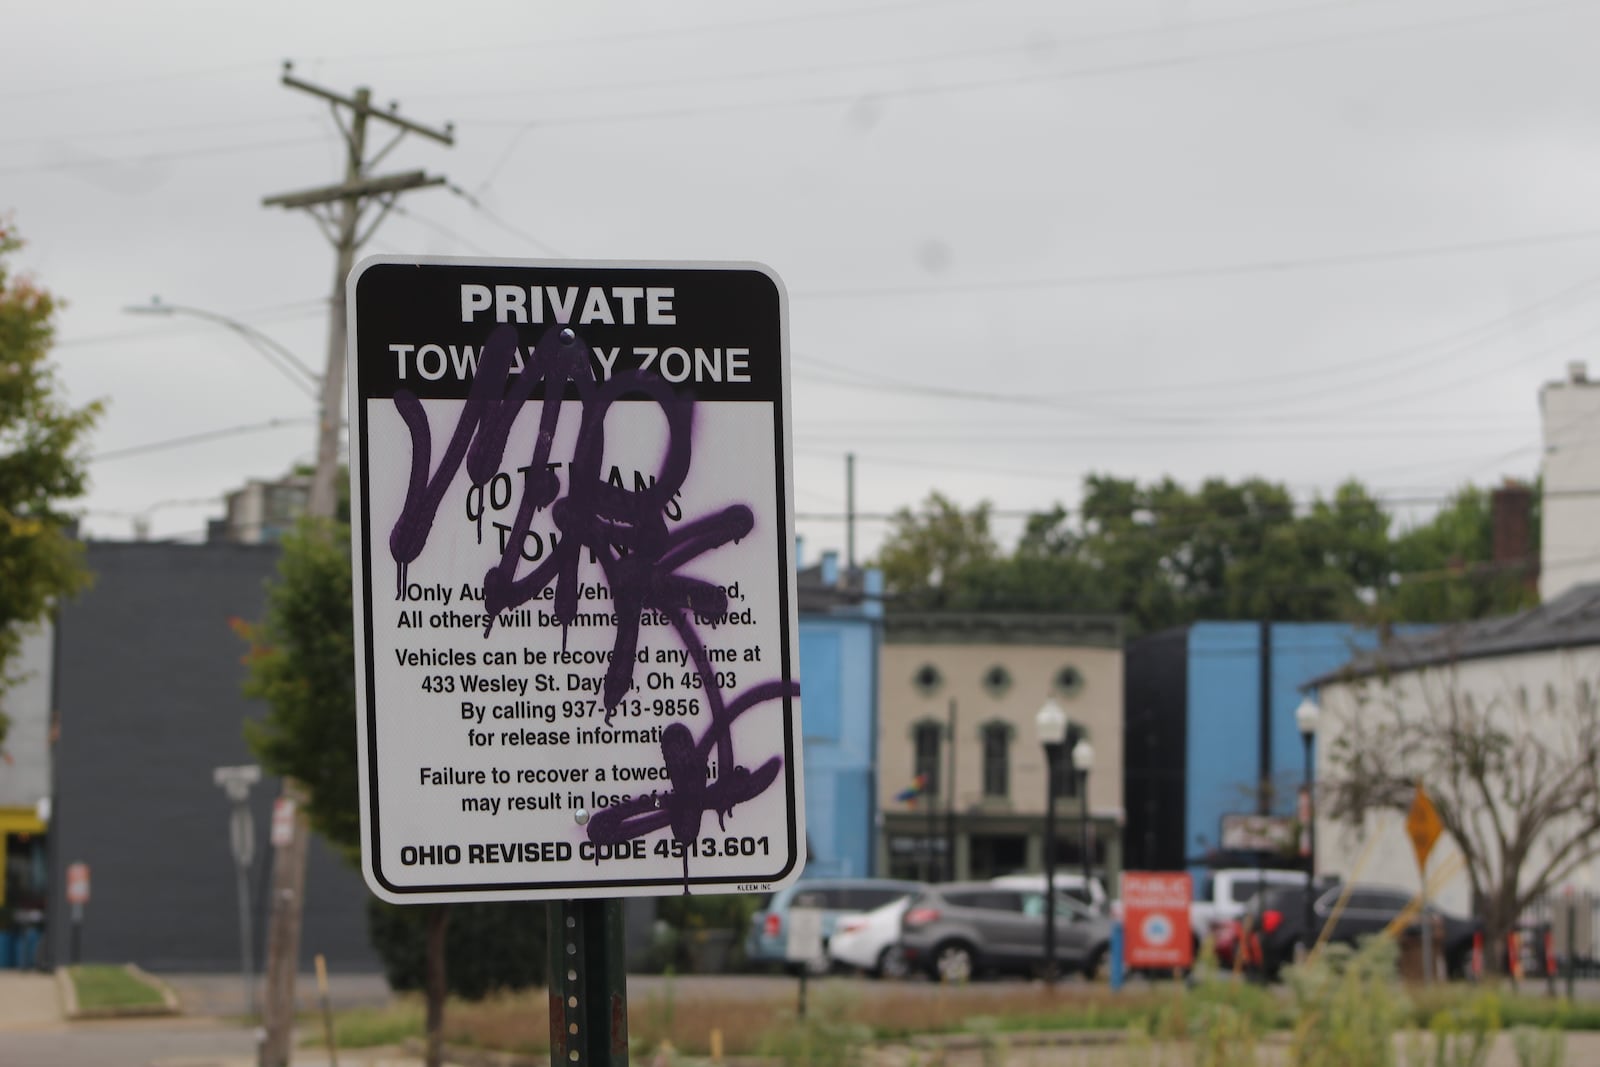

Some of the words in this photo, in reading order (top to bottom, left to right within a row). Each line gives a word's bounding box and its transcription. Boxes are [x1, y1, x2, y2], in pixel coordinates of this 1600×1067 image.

[461, 284, 677, 325] PRIVATE
[632, 347, 751, 383] ZONE
[407, 583, 453, 605] Only
[397, 612, 422, 628] All
[430, 612, 492, 628] others
[499, 611, 531, 628] will
[539, 611, 561, 628] be
[395, 648, 476, 666] Vehicles
[483, 651, 517, 665] can
[524, 648, 546, 665] be
[553, 647, 648, 665] recoved
[656, 649, 689, 668] any
[703, 646, 737, 662] ime
[743, 645, 761, 662] at
[421, 676, 455, 693] 433
[460, 675, 528, 697] Wesley
[535, 675, 560, 692] St.
[646, 672, 674, 690] Oh
[681, 672, 737, 689] 4503
[461, 702, 485, 724] By
[493, 700, 556, 723] calling
[468, 728, 494, 747] for
[501, 727, 570, 746] release
[576, 726, 665, 745] informati
[420, 768, 486, 786] Failure
[492, 769, 511, 785] to
[517, 768, 589, 785] recover
[595, 769, 605, 782] a
[612, 766, 669, 782] towed
[461, 797, 500, 815] may
[508, 793, 561, 811] result
[568, 793, 584, 809] in
[591, 792, 631, 809] loss
[400, 844, 461, 865] OHIO
[469, 841, 572, 864] REVISED
[579, 839, 647, 861] CODE
[654, 836, 770, 858] 4513.601
